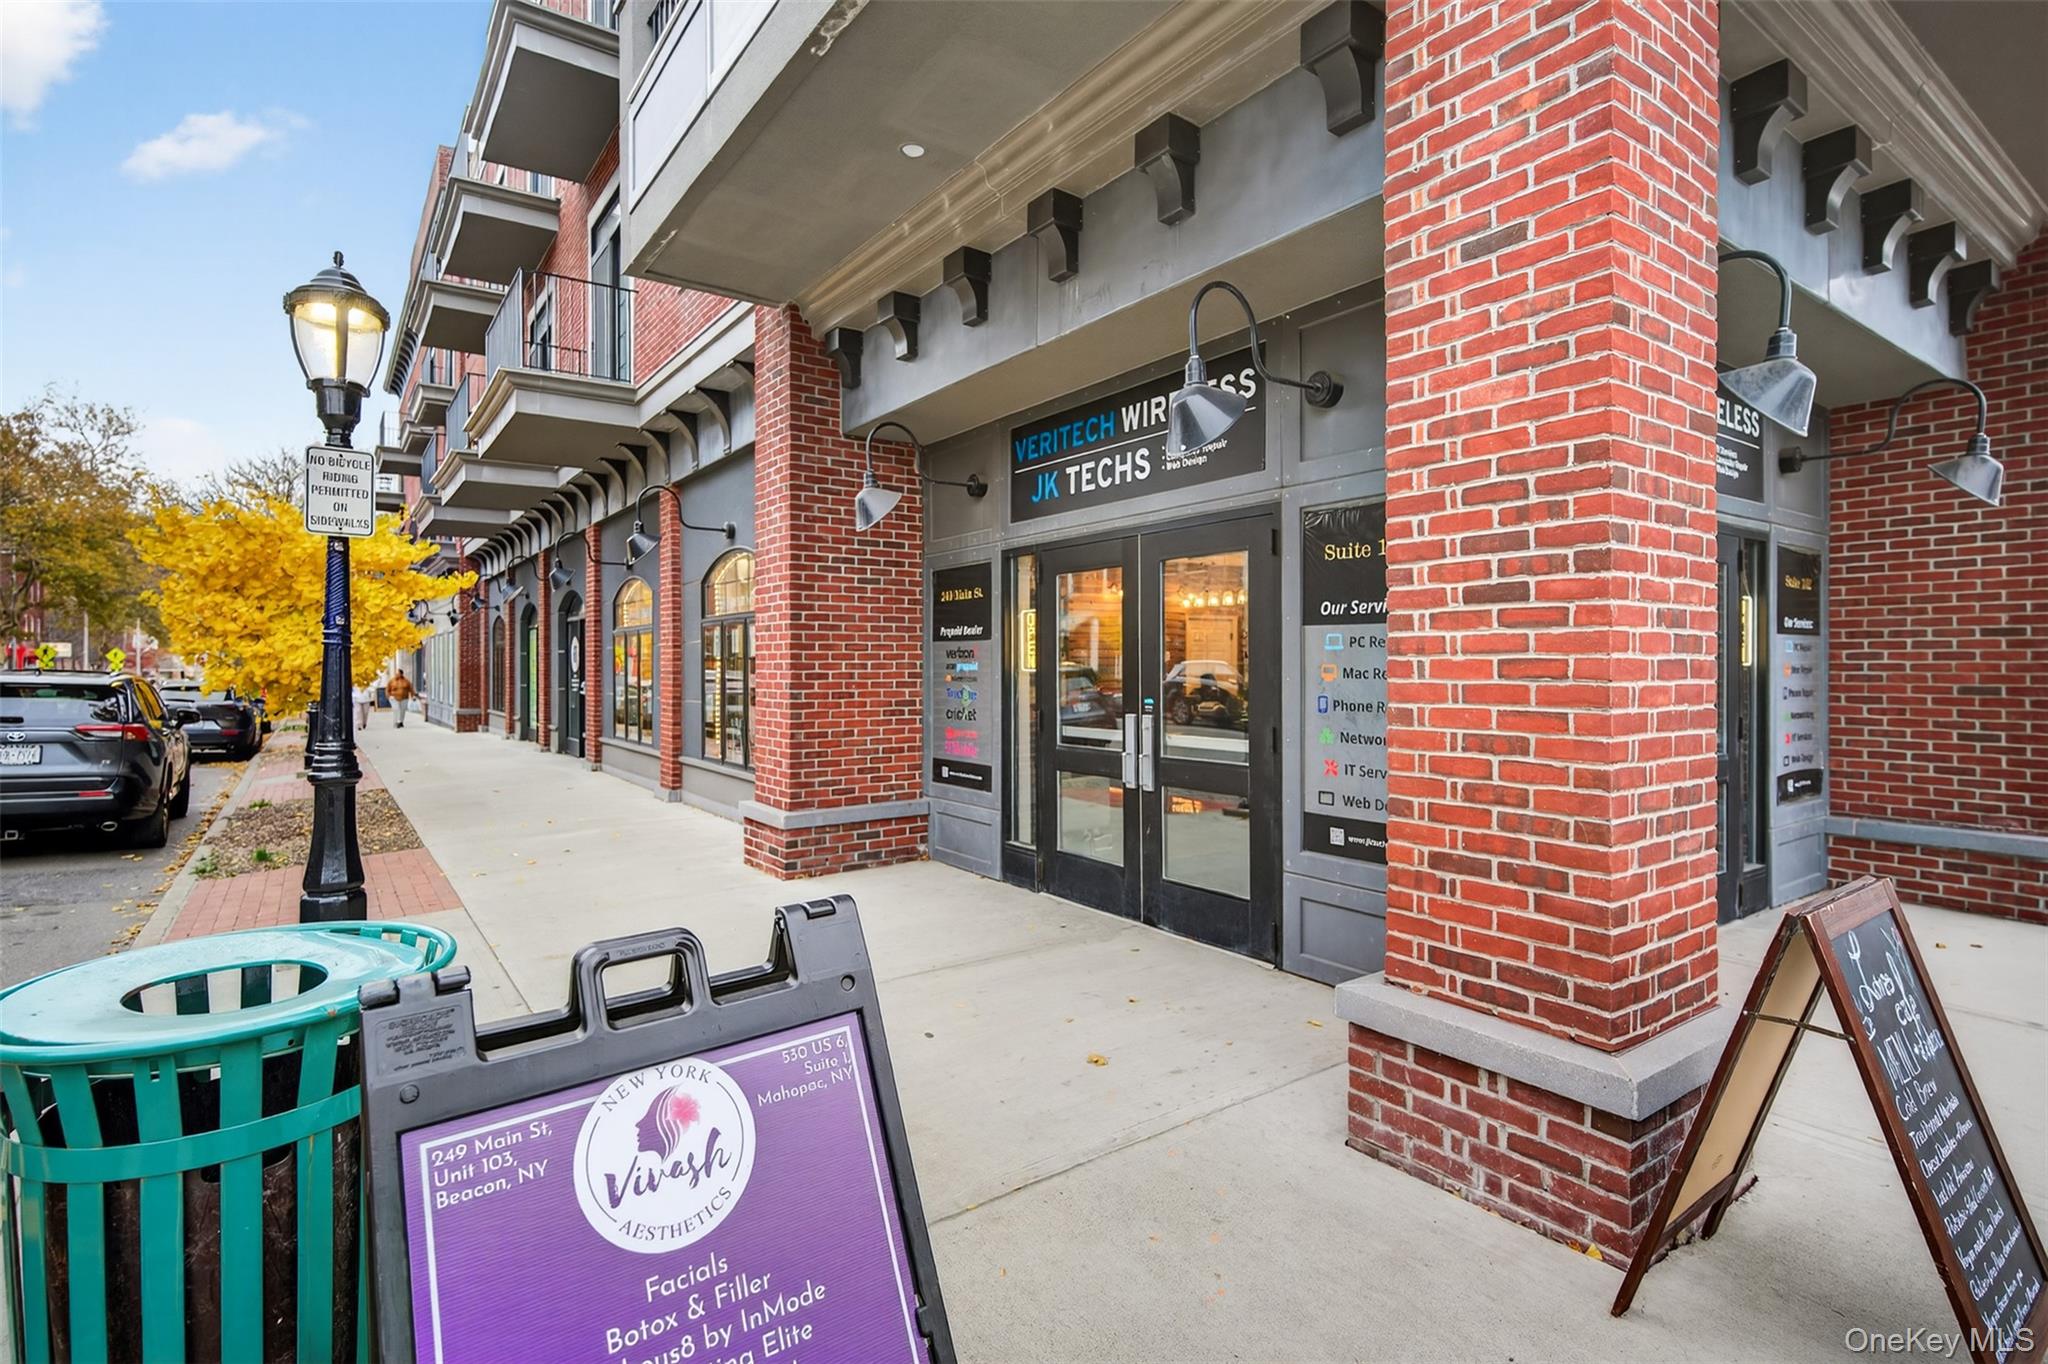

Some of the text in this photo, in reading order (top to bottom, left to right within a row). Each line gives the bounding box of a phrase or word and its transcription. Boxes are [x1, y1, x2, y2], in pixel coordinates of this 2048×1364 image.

[1015, 367, 1256, 463] VERITECH WIRSS
[1717, 397, 1760, 438] ELESS
[310, 455, 371, 471] NO BICYCLE
[322, 471, 359, 484] RIDING
[1031, 447, 1151, 502] JK TECHS
[311, 484, 369, 500] PERMITTED
[333, 502, 348, 512] ON
[310, 515, 370, 529] SIDEWALKS
[1324, 541, 1371, 561] Suite
[1320, 598, 1387, 616] Our Servi
[1349, 636, 1366, 648] PC
[1342, 667, 1369, 680] Mac
[1333, 699, 1373, 713] Phone
[1344, 764, 1387, 780] IT Serv
[1342, 794, 1371, 810] Web
[781, 1034, 848, 1064] 530 US 6,
[804, 1057, 838, 1075] Suite
[1877, 1028, 1921, 1091] MENU
[601, 1063, 712, 1112] NEW YORK
[757, 1065, 853, 1107] Mahopac, NY
[1895, 1086, 1919, 1121] Cold
[1913, 1077, 1938, 1106] Brew
[431, 1120, 554, 1167] 249 Main St,
[433, 1150, 519, 1187] Unit 103,
[435, 1159, 549, 1210] Beacon, NY
[604, 1126, 732, 1209] Vivash
[618, 1186, 732, 1241] AESTHETICS
[644, 1251, 729, 1303] Facials
[606, 1311, 678, 1355] Botox
[687, 1293, 705, 1319] &
[714, 1270, 771, 1309] Filler
[703, 1279, 826, 1349] by InMode
[761, 1324, 813, 1358] Elite
